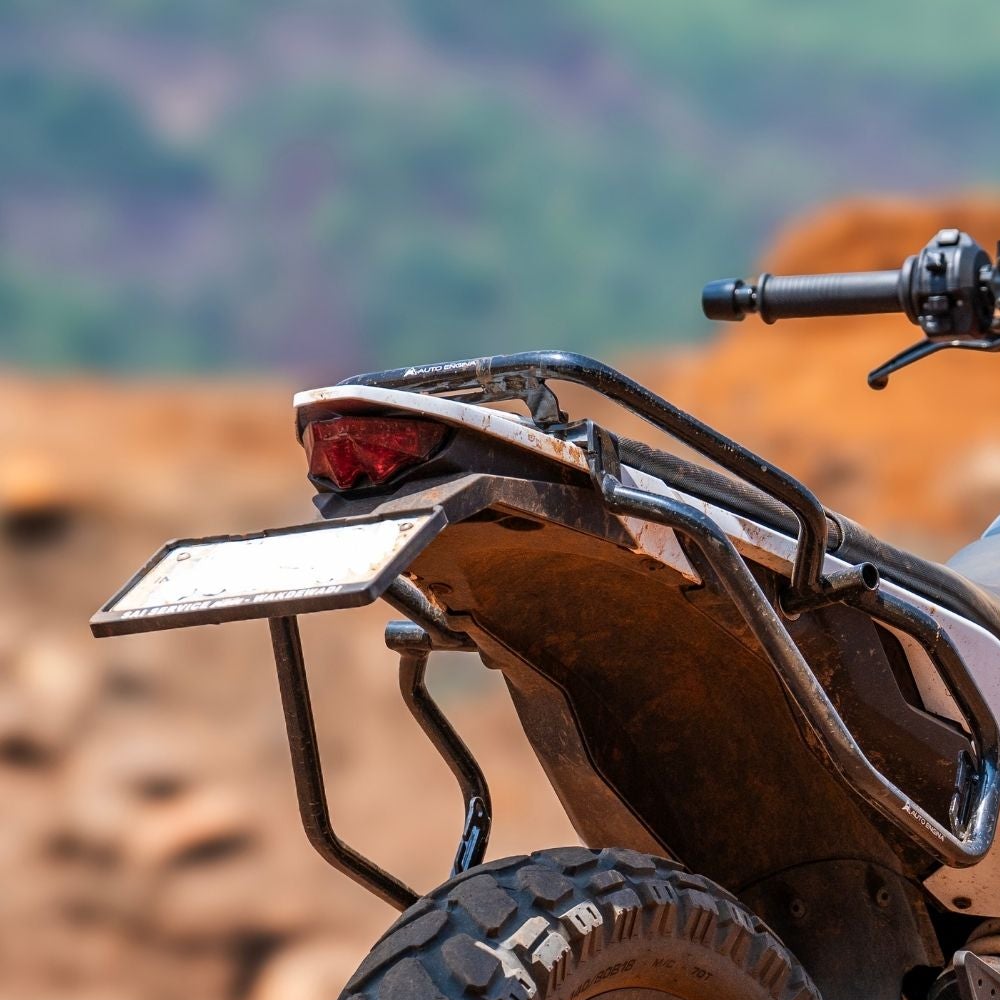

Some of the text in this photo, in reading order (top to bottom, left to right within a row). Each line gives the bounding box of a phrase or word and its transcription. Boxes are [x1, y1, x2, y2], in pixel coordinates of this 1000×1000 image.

[417, 361, 476, 374] AUTO ENGINA
[120, 609, 146, 619] SAI
[147, 602, 209, 616] SERVICE
[253, 585, 342, 602] WAKDEWADI
[910, 811, 925, 825] AUTO
